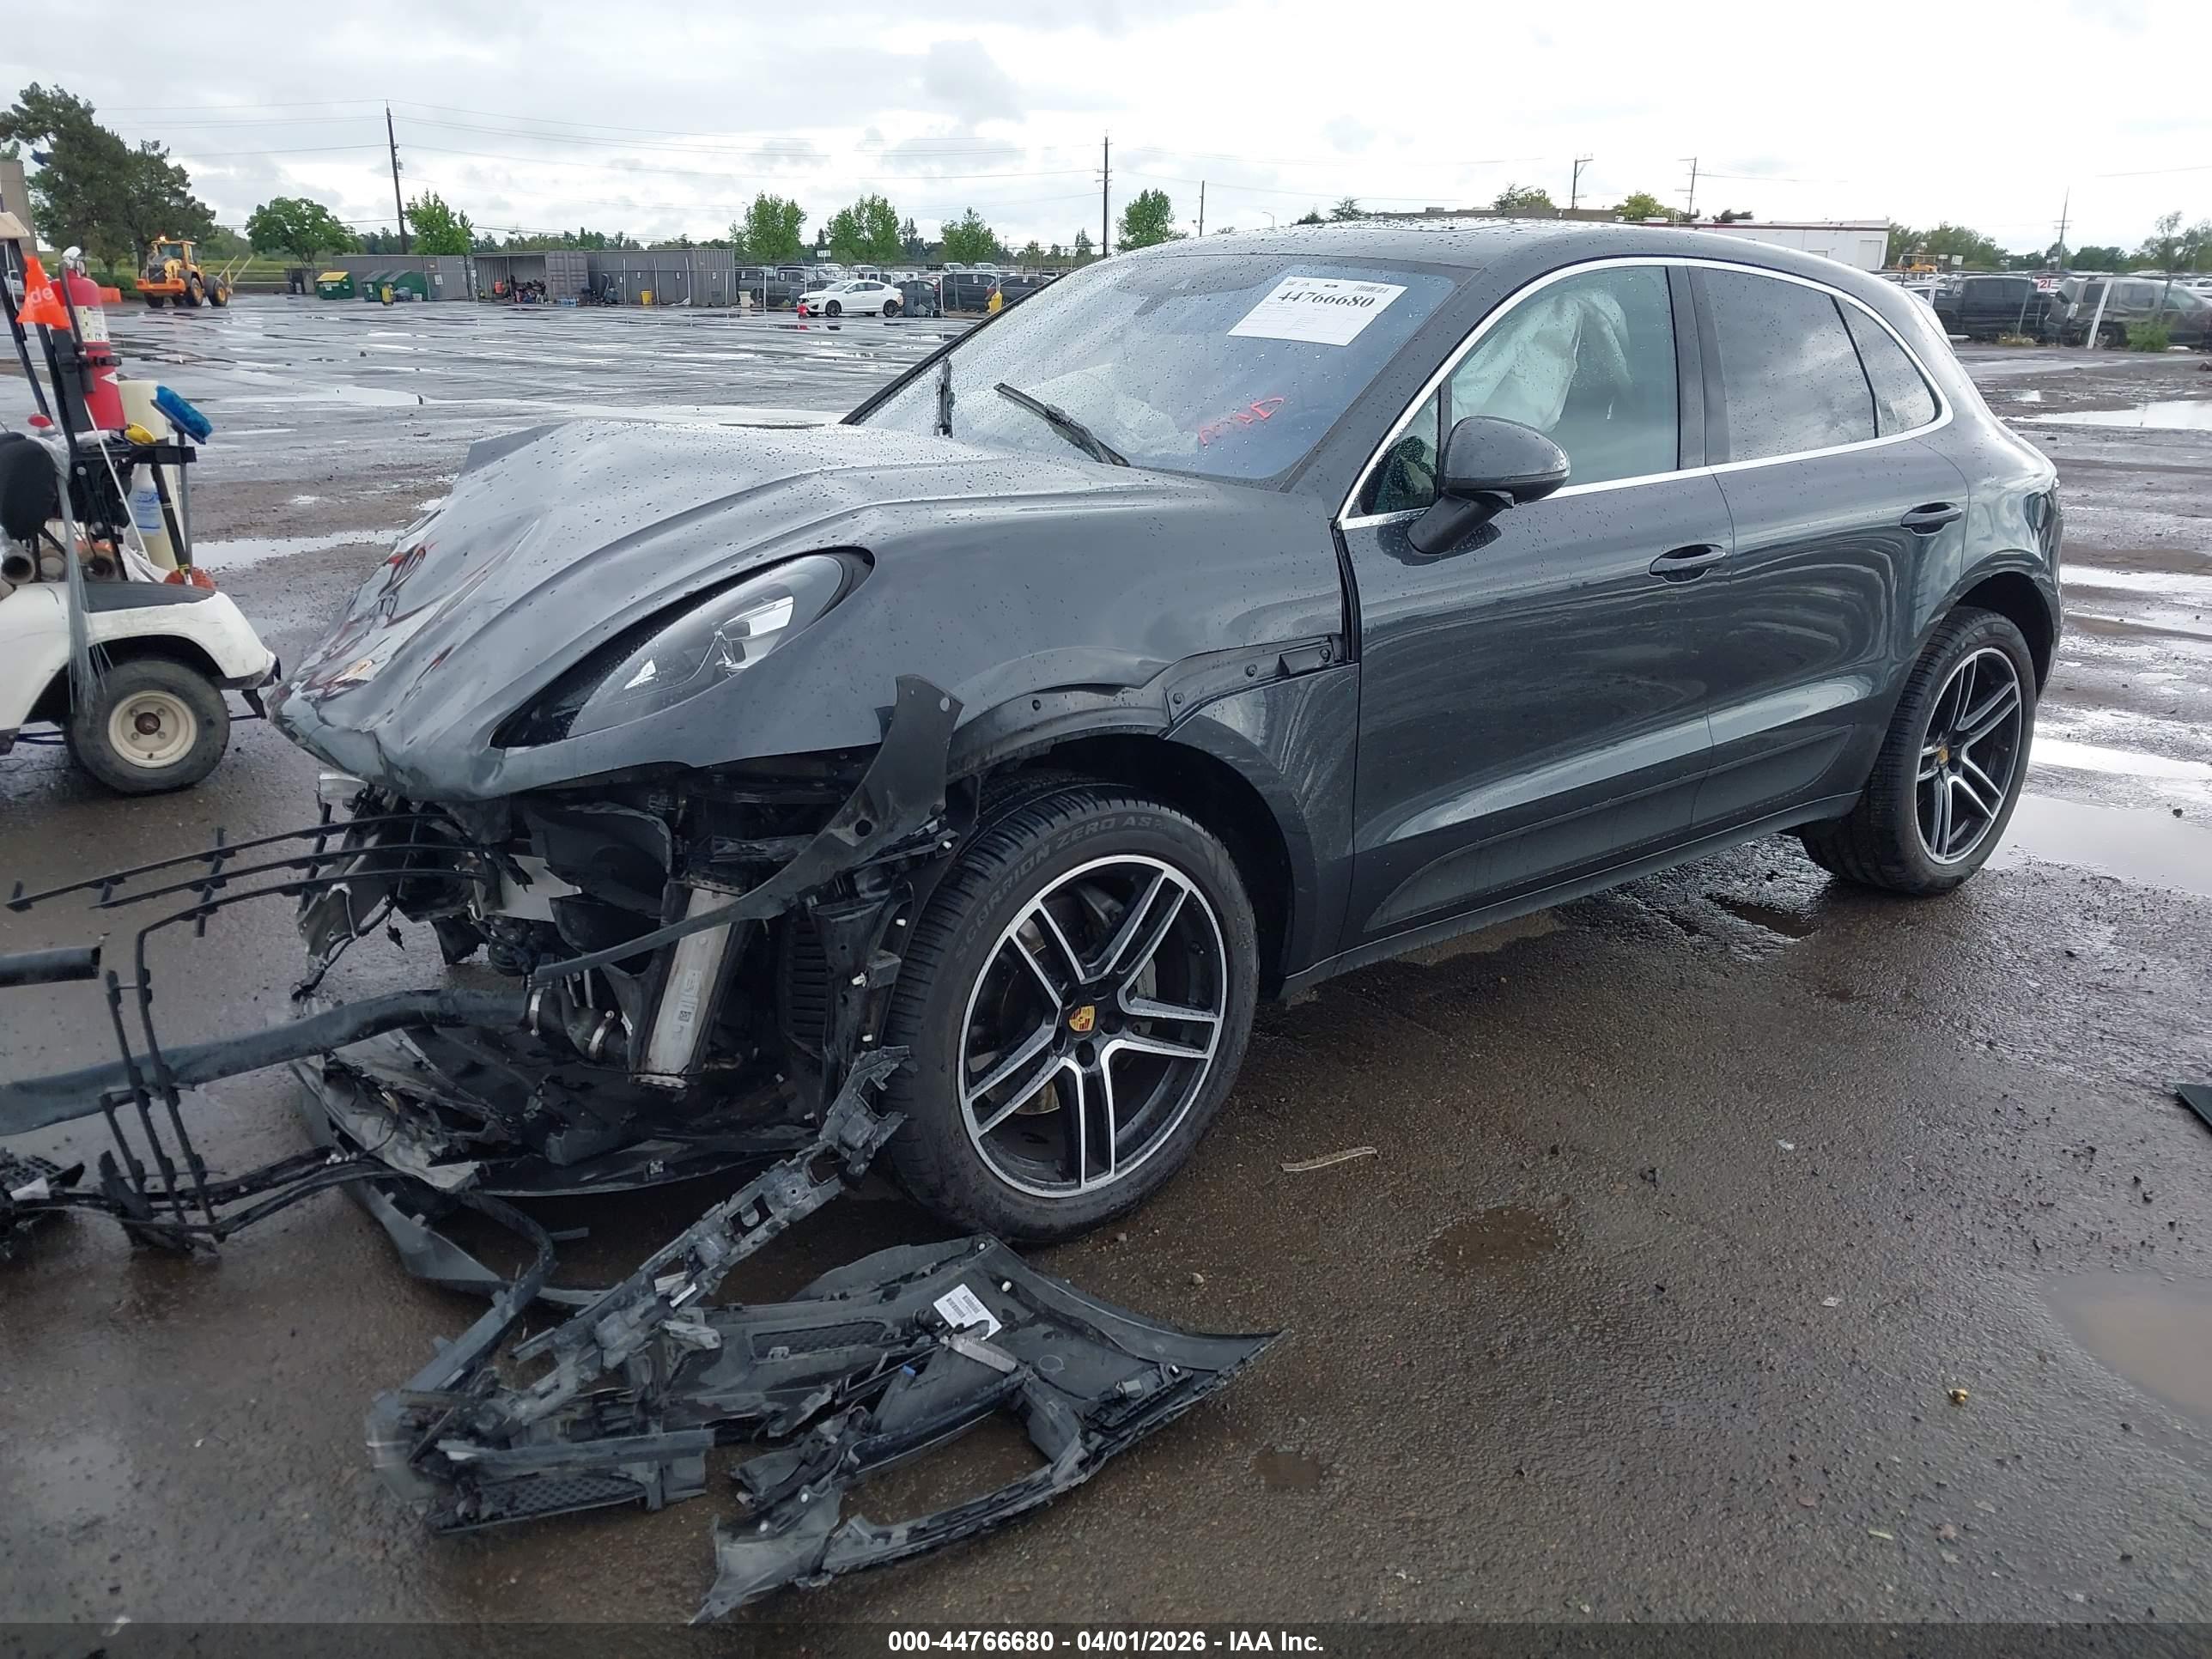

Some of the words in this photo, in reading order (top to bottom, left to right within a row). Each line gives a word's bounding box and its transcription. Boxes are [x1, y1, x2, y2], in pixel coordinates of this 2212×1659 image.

[2039, 279, 2051, 289] 21
[1278, 290, 1376, 308] 44766680
[1057, 817, 1116, 849] ZERO
